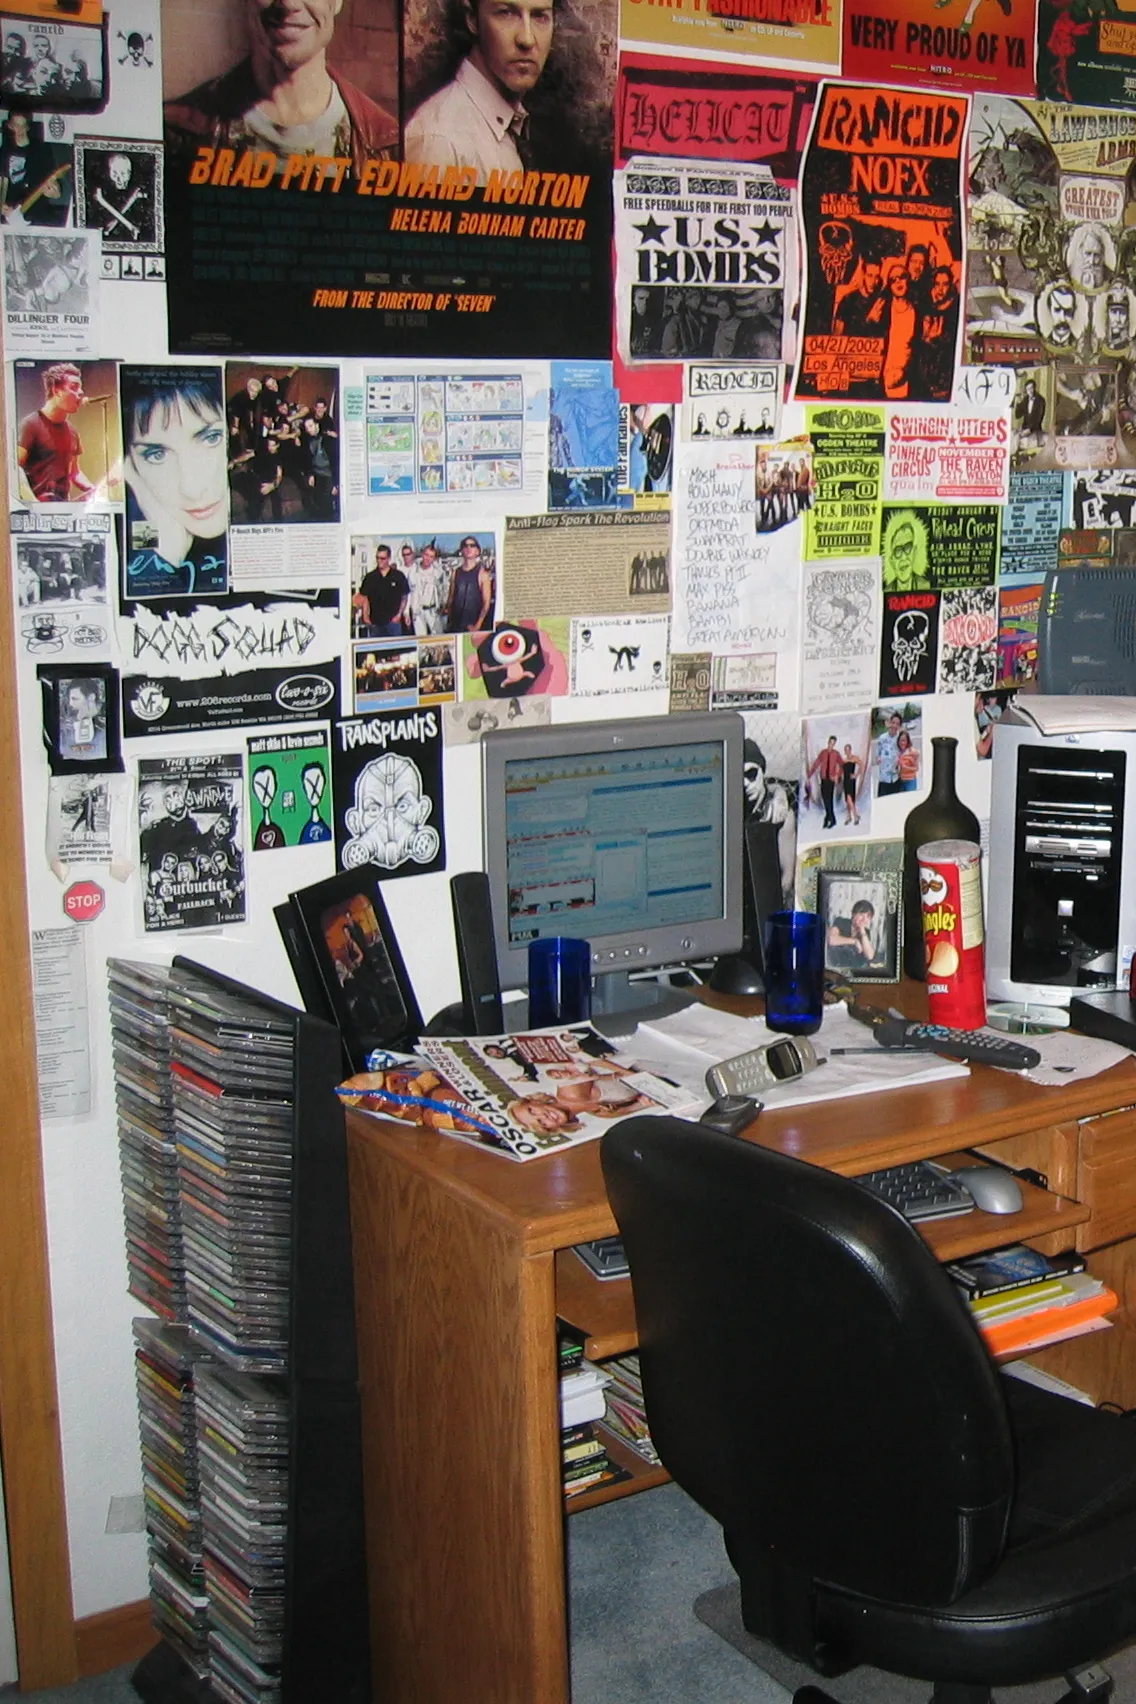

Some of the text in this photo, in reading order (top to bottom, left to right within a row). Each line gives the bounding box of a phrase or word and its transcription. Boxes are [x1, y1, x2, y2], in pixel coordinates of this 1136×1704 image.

[28, 24, 65, 35] rancid
[1101, 22, 1126, 41] Shut
[850, 13, 1026, 69] VERY PROUD OF YA
[629, 92, 791, 145] HELLCAT
[823, 94, 960, 148] RANCID
[1096, 139, 1136, 167] ARMS
[188, 147, 278, 189] BRAD
[280, 153, 353, 193] PITT
[357, 158, 478, 202] EDWARD
[483, 168, 591, 209] NORTON
[850, 154, 933, 197] NOFX
[623, 197, 794, 218] FREE SPEEDBALLS FOR THE FIRST 100 PEOPLE
[1064, 187, 1120, 208] GREATEST
[390, 208, 587, 241] HELENA BONHAM CARTER
[674, 217, 750, 249] U.S.
[636, 249, 781, 285] BOMBS
[313, 288, 452, 311] FROM THE DIRECTOR OF
[7, 313, 90, 325] DILLINGER FOUR
[805, 356, 881, 376] Los Angeles
[694, 370, 774, 391] RANCID
[845, 438, 879, 448] THEATRE
[889, 444, 993, 465] PINHEAD NOVEMBER
[891, 459, 932, 478] CIRCUS
[940, 458, 962, 472] THE
[966, 458, 1004, 473] RAVEN
[508, 510, 669, 529] Anti-Flag Spark The Revolution
[820, 503, 871, 518] U.S. BOMBS
[966, 517, 996, 540] Circus
[128, 554, 226, 595] enya
[888, 594, 937, 611] RANCID
[1001, 605, 1038, 617] RANCID
[335, 711, 438, 751] TRANSPLANTS
[165, 757, 187, 767] THE
[160, 877, 229, 897] Gutbucket
[67, 894, 101, 911] STOP
[421, 1040, 463, 1089] WINNERS
[462, 1086, 538, 1156] OSCAR
